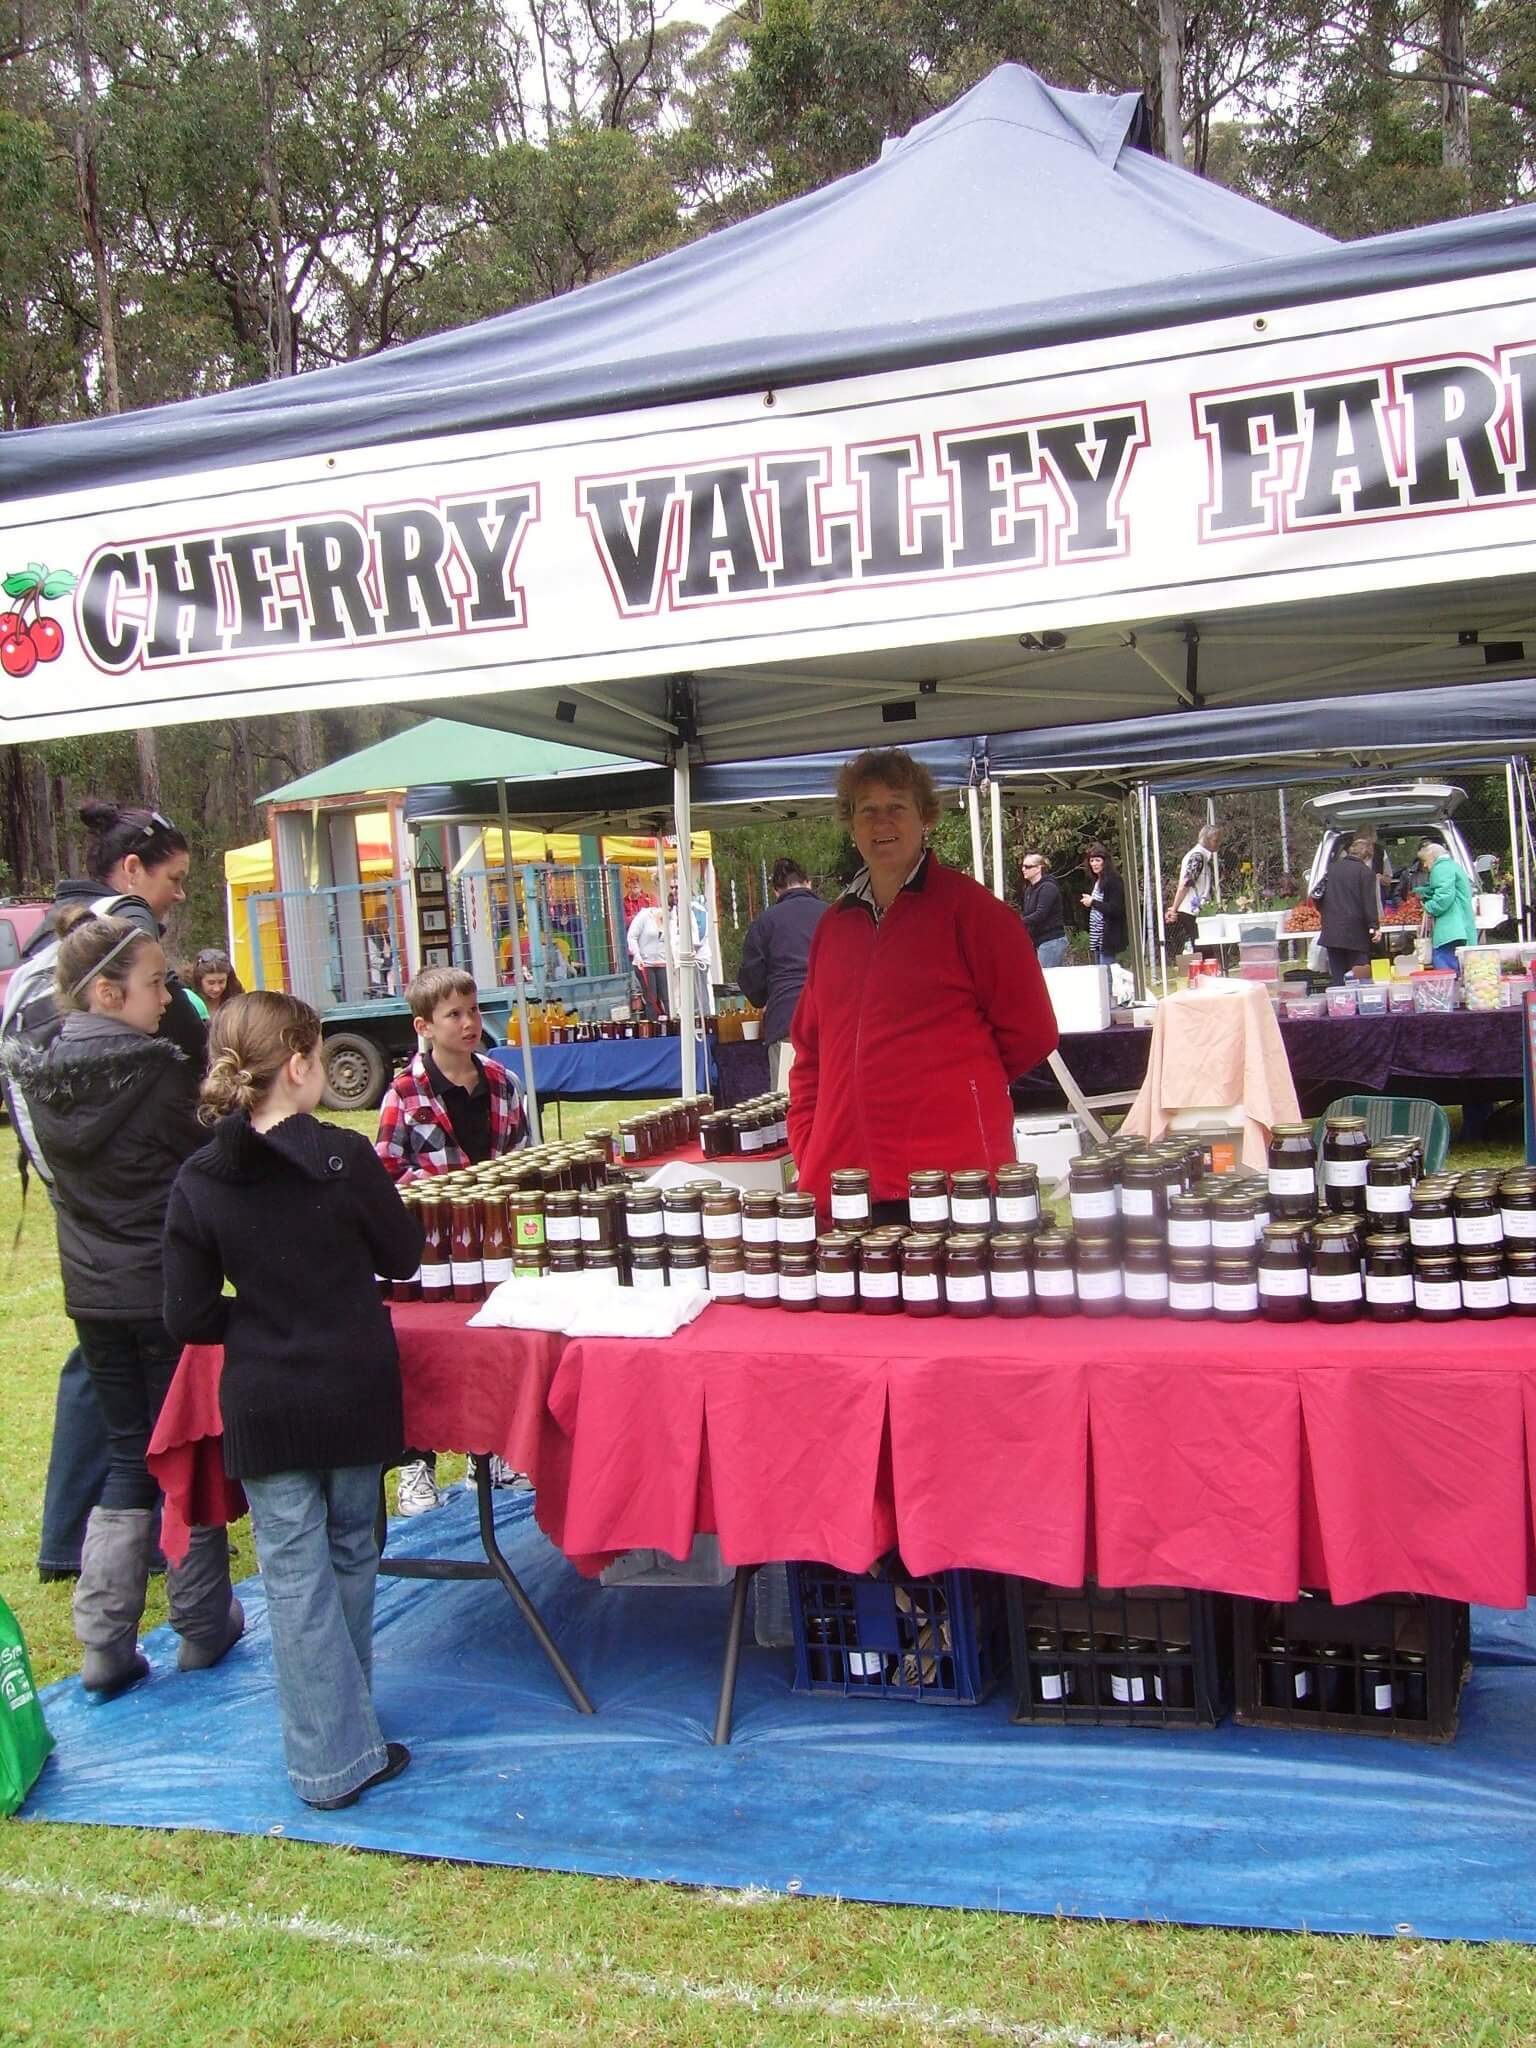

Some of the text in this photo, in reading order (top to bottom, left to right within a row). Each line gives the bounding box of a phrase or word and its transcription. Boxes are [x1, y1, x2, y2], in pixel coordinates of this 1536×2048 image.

[74, 341, 1536, 676] CHERRY VALLEY FAR
